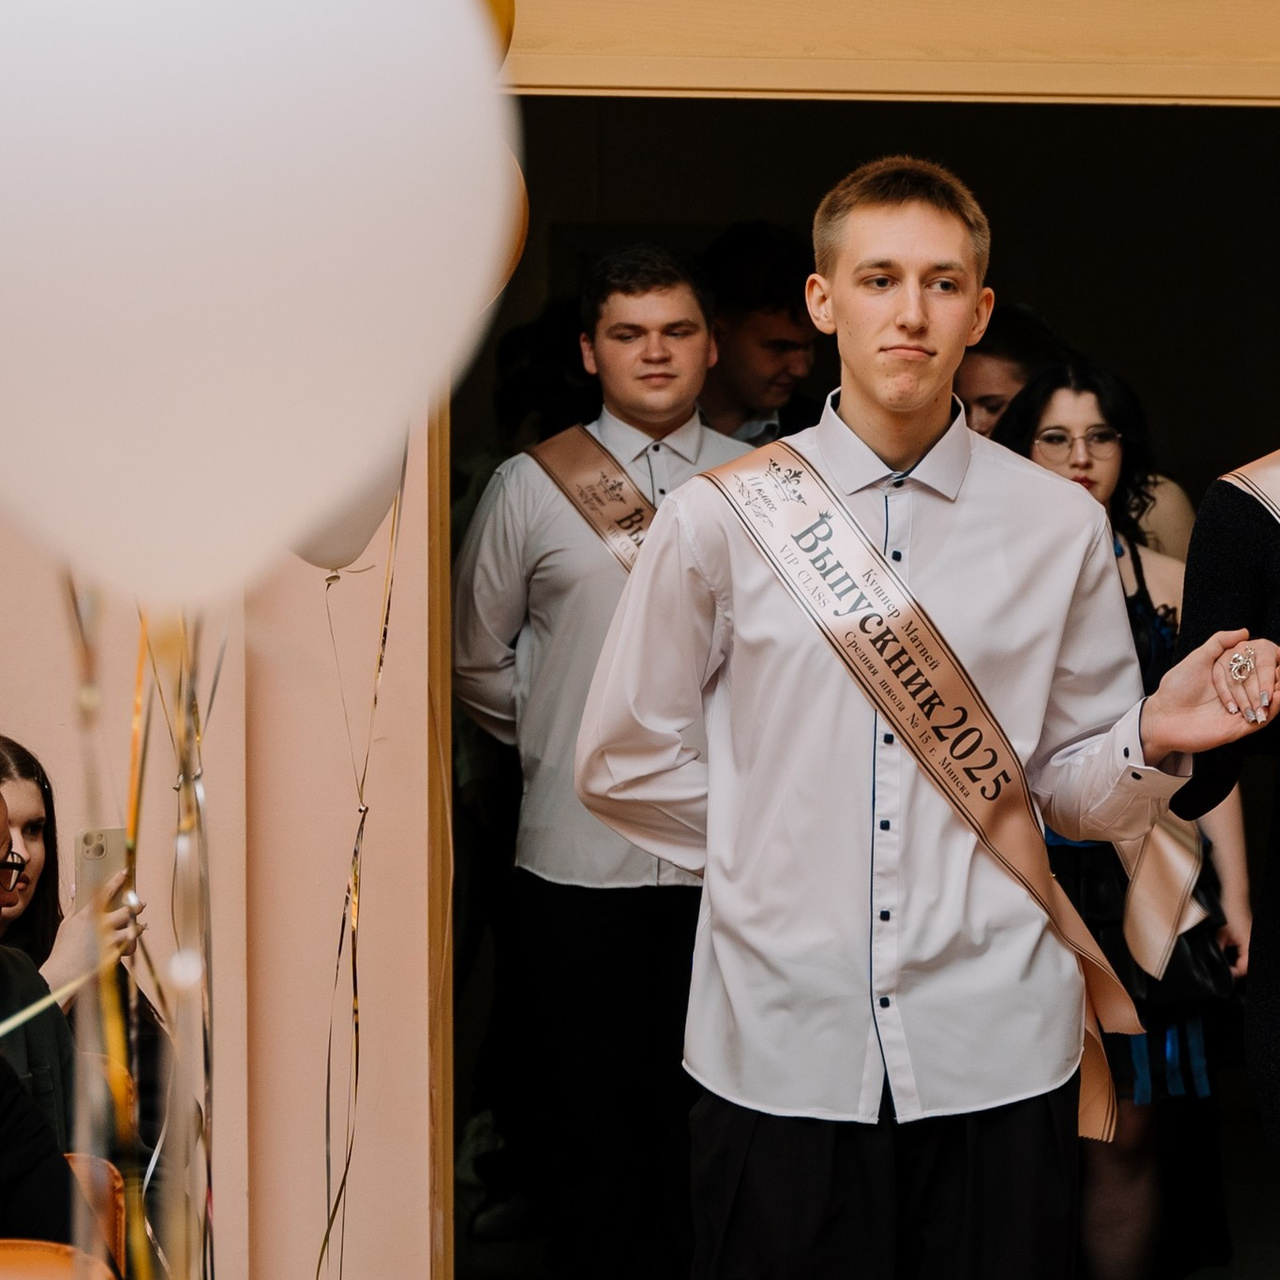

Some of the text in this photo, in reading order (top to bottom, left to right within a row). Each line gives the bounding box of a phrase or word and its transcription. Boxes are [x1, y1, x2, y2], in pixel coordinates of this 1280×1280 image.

[779, 543, 831, 609] VIP CLASS
[861, 568, 942, 672] Кушнер Матвей
[844, 630, 880, 678] Средняя
[878, 679, 906, 714] школа
[905, 712, 920, 730] №
[918, 730, 932, 745] 15
[937, 756, 971, 799] Минска
[930, 706, 1013, 803] 2025
